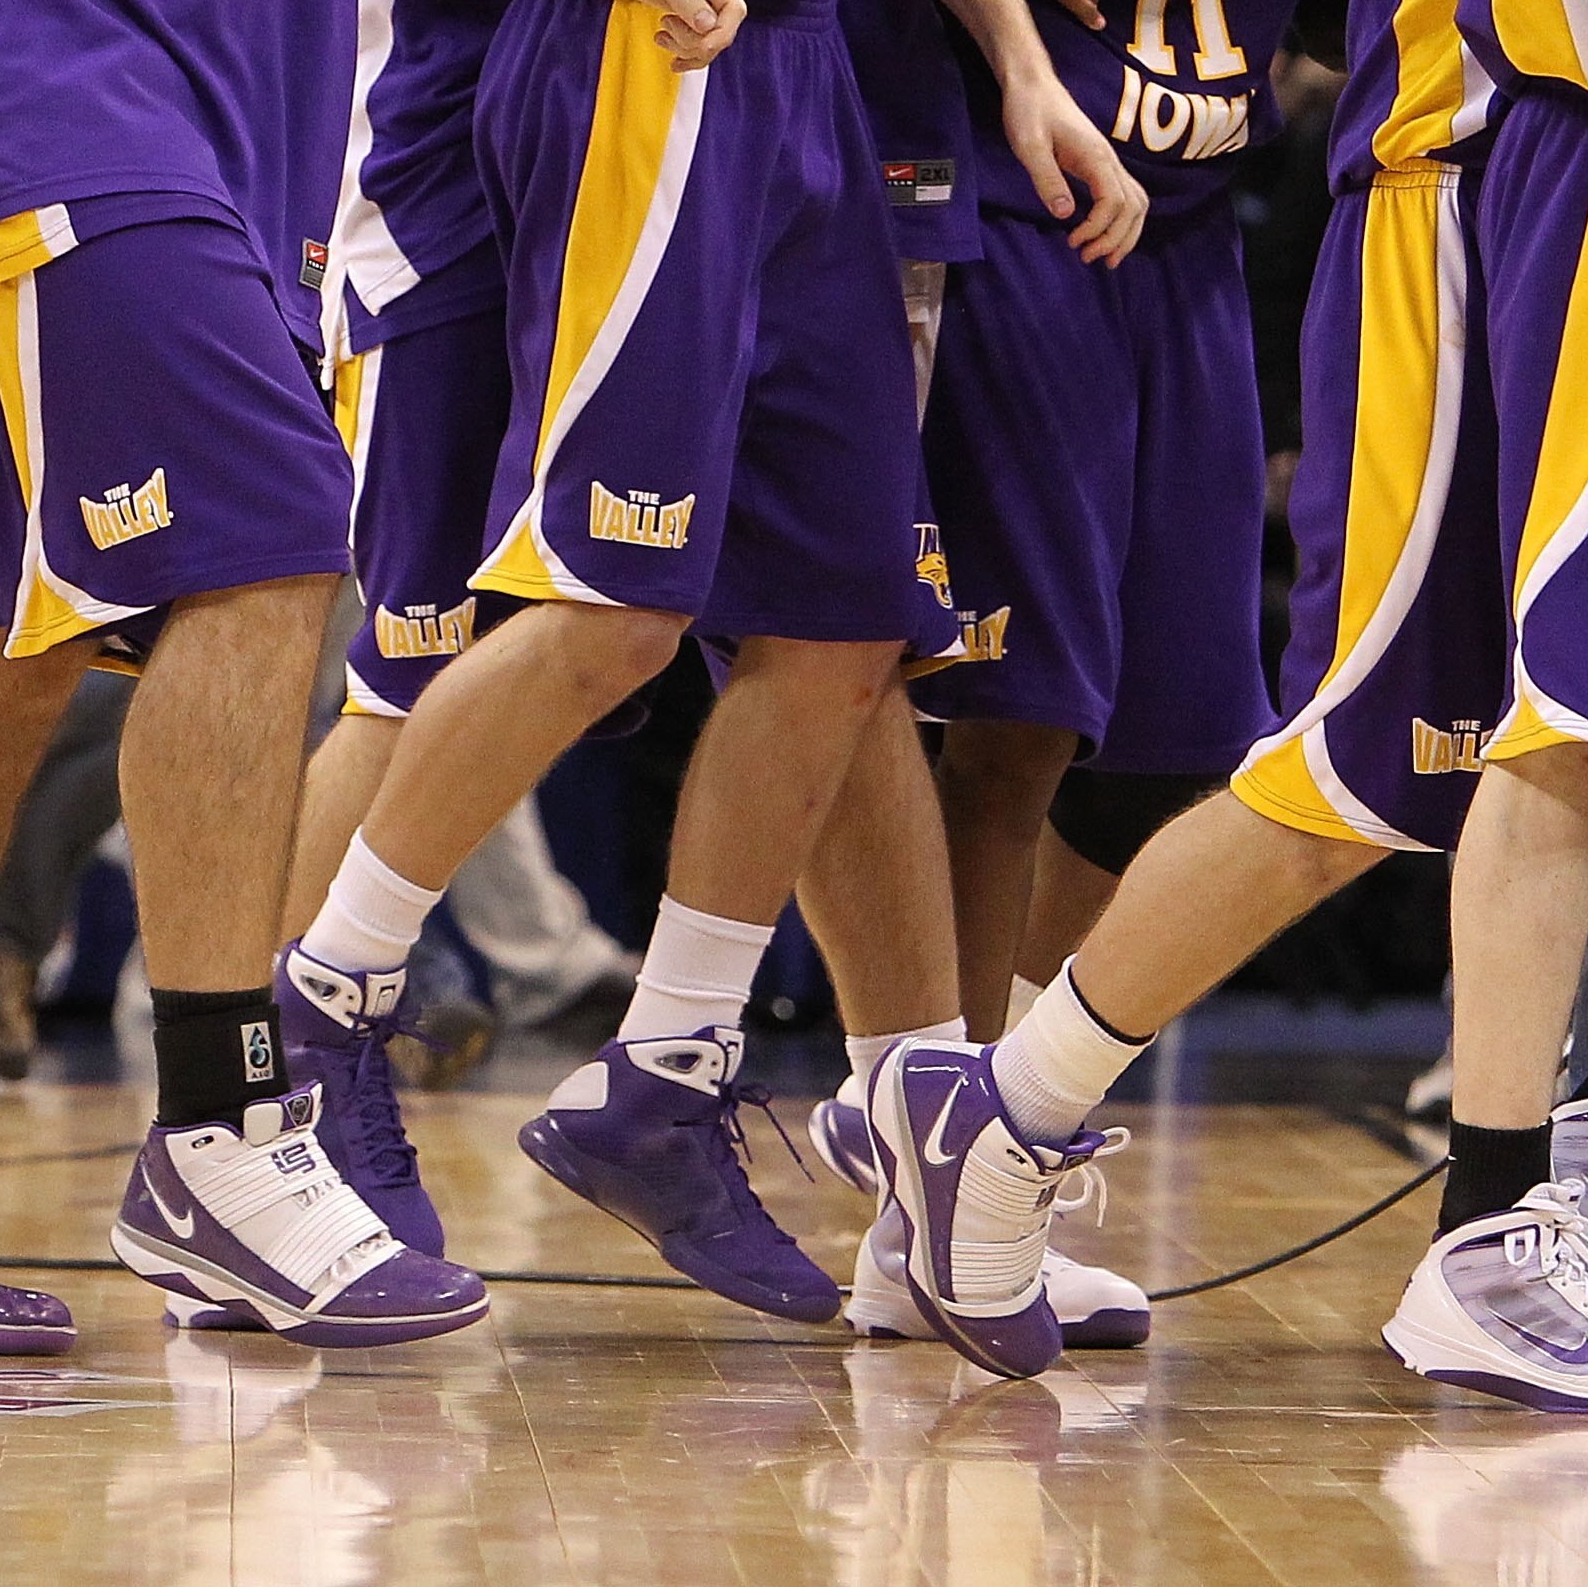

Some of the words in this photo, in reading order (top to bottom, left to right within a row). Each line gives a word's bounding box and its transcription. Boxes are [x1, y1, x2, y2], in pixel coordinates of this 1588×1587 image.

[78, 466, 173, 551] VALLEY
[103, 482, 131, 503] THE
[589, 479, 696, 550] VALLEY
[627, 489, 661, 506] THE
[374, 596, 477, 660] VALLEY
[1412, 716, 1495, 774] VALL
[1451, 719, 1482, 732] THE
